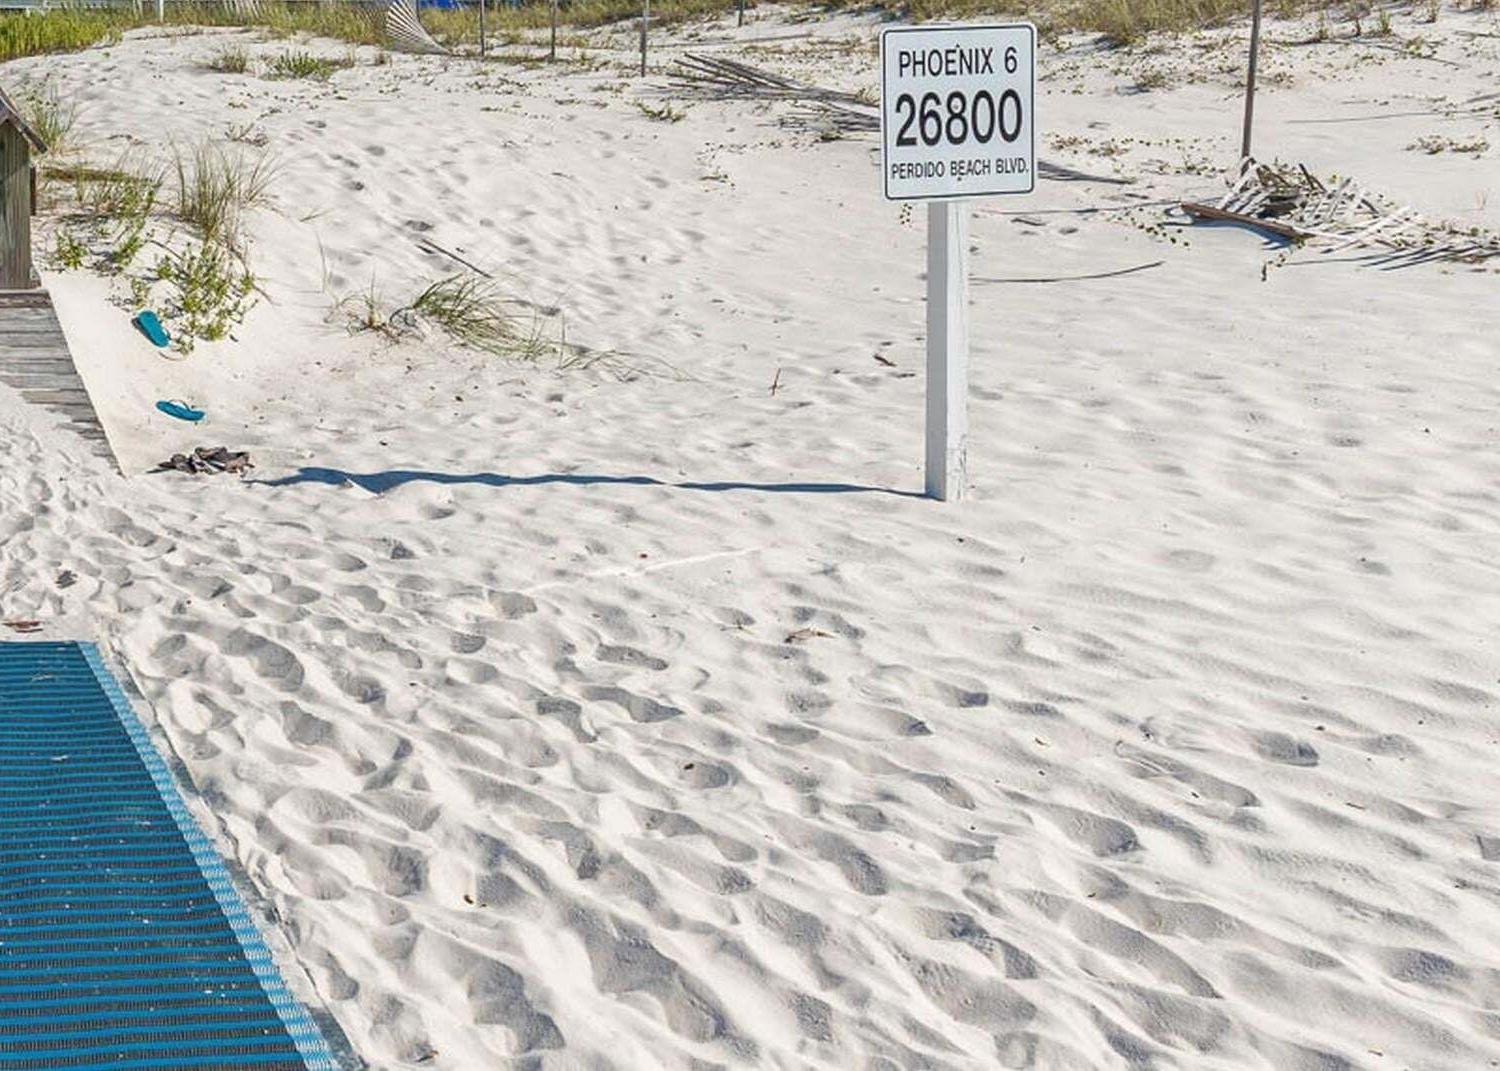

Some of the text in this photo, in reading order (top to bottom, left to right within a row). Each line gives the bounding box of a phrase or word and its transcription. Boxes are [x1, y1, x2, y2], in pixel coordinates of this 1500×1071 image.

[899, 47, 1018, 77] PHOENIX 6
[895, 89, 1023, 147] 26800
[891, 157, 1030, 179] PERDIDO BEACH BLVD.
